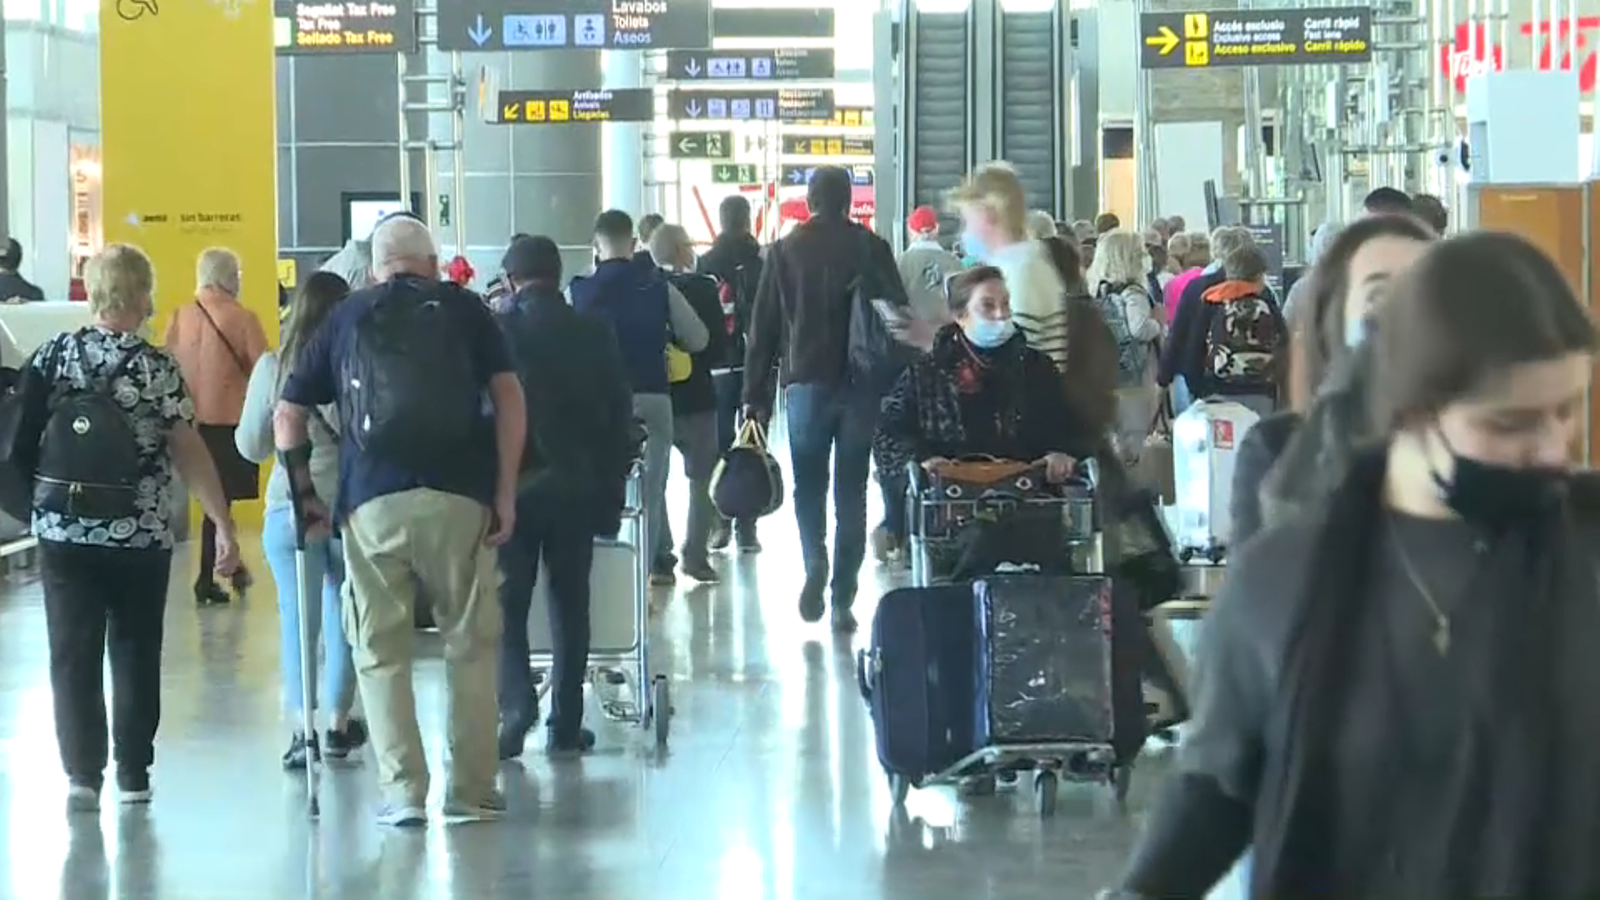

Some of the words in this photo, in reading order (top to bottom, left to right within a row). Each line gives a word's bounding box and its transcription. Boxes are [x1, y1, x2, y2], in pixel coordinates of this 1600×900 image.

[346, 2, 367, 16] Tax
[370, 2, 397, 16] Free
[612, 0, 668, 13] Lavabos
[297, 18, 315, 30] Tax
[317, 18, 341, 30] Free
[613, 14, 649, 29] Toilets
[1303, 17, 1332, 29] Carril
[296, 31, 341, 45] Sellado
[343, 31, 365, 45] Tax
[367, 30, 394, 45] Free
[613, 30, 652, 45] Aseos
[1213, 42, 1250, 55] Acceso
[1250, 40, 1297, 54] exclusivo
[1303, 40, 1332, 52] Carril
[1333, 39, 1366, 53] rápido
